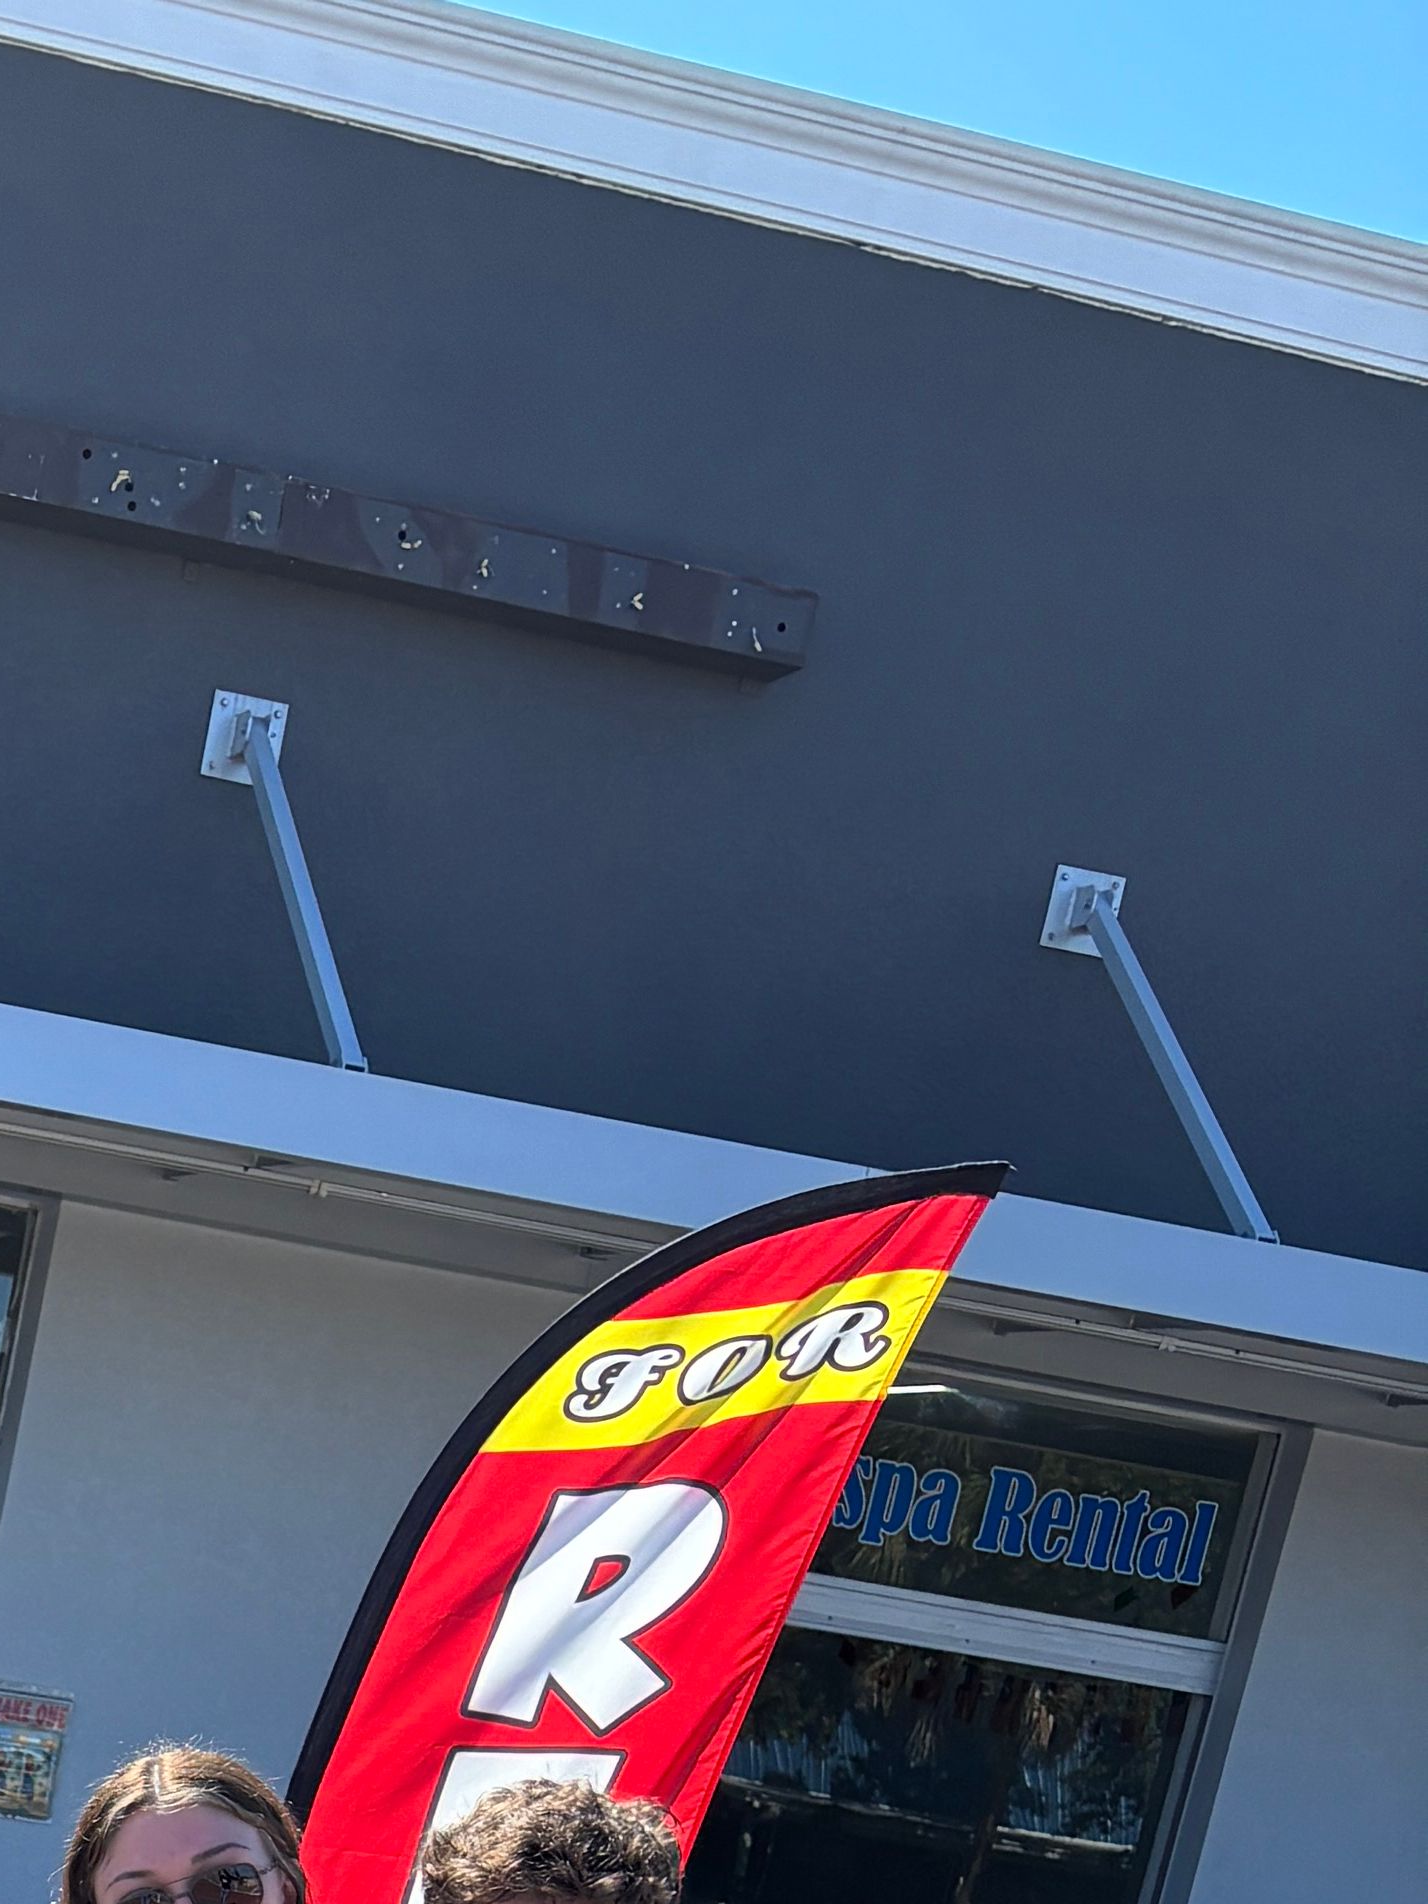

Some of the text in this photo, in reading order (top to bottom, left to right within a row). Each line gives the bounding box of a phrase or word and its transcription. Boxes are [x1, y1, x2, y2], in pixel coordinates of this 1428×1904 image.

[564, 1300, 892, 1423] FOR
[973, 1466, 1219, 1586] Rental
[36, 1704, 70, 1729] ONE
